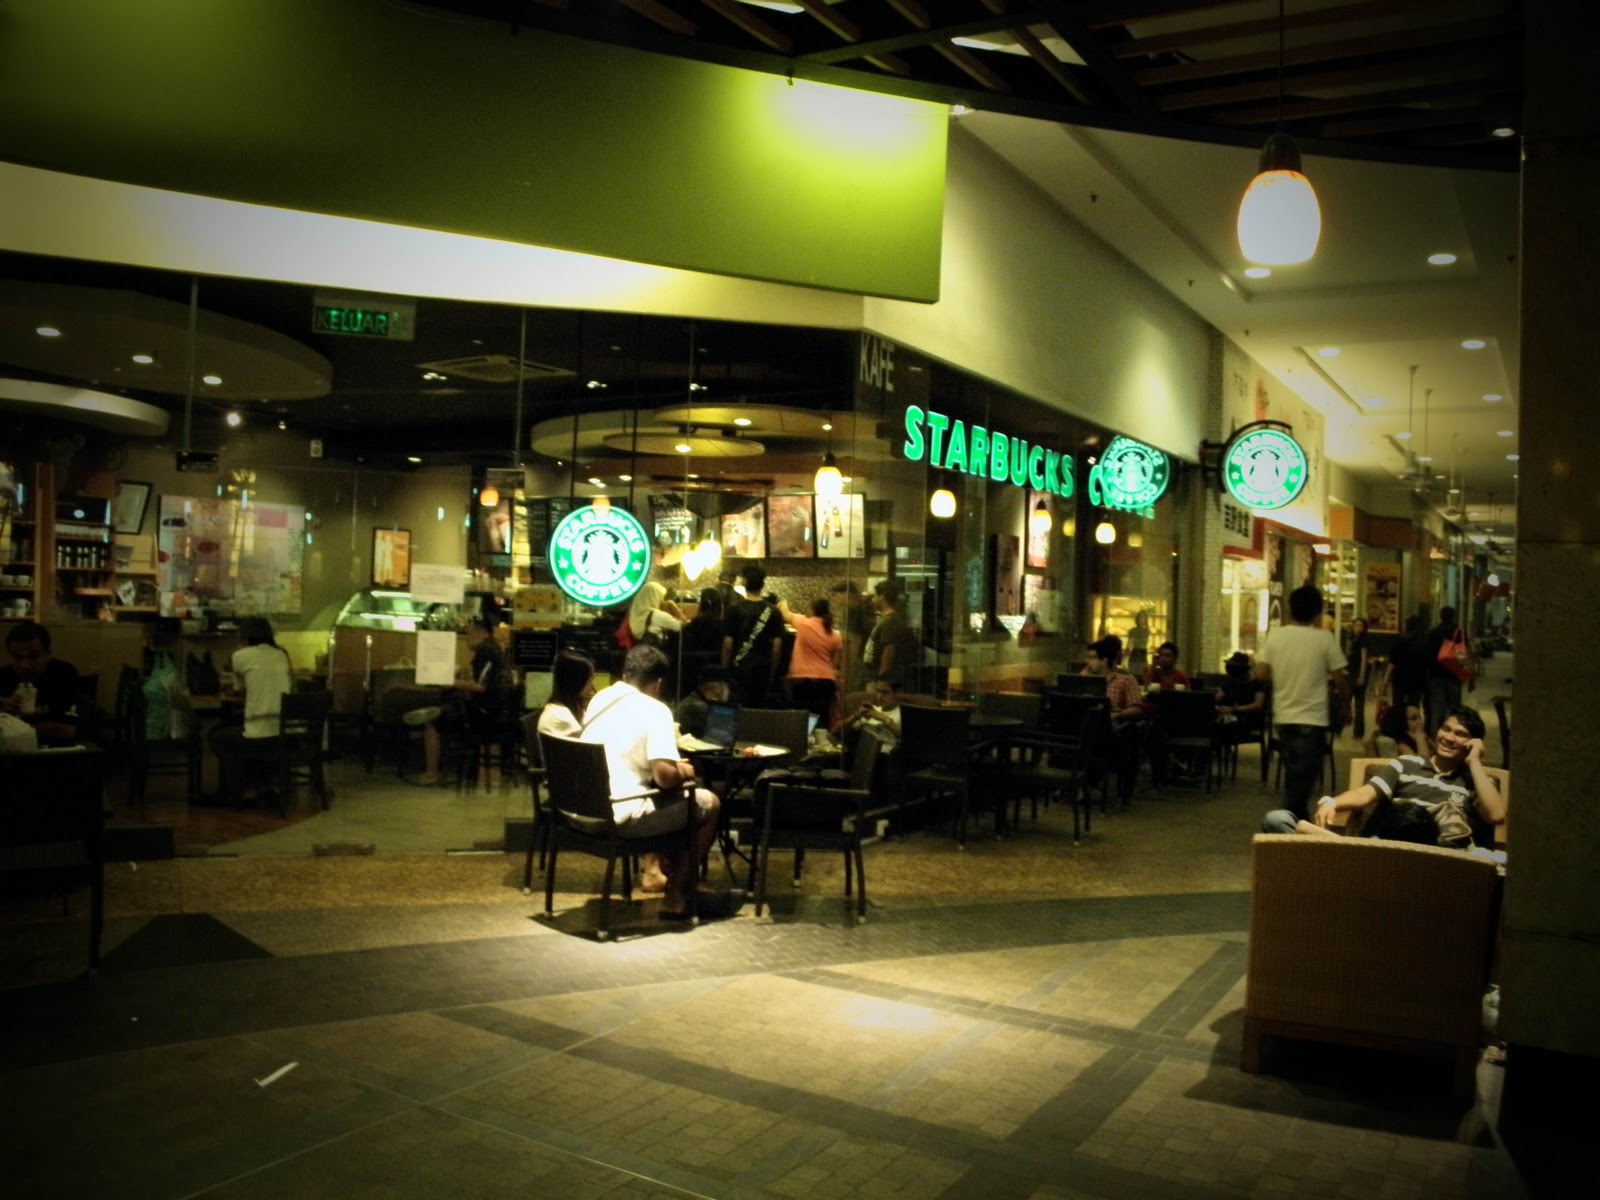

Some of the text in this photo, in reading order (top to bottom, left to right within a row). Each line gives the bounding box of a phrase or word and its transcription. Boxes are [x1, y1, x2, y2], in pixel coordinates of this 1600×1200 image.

[316, 308, 388, 335] KELUAR
[859, 331, 895, 392] KAFE
[903, 404, 1075, 499] STARBUCKS
[1230, 433, 1301, 468] STARBUCKS
[557, 510, 645, 553] STARBUCKS
[565, 573, 633, 600] COFFEE
